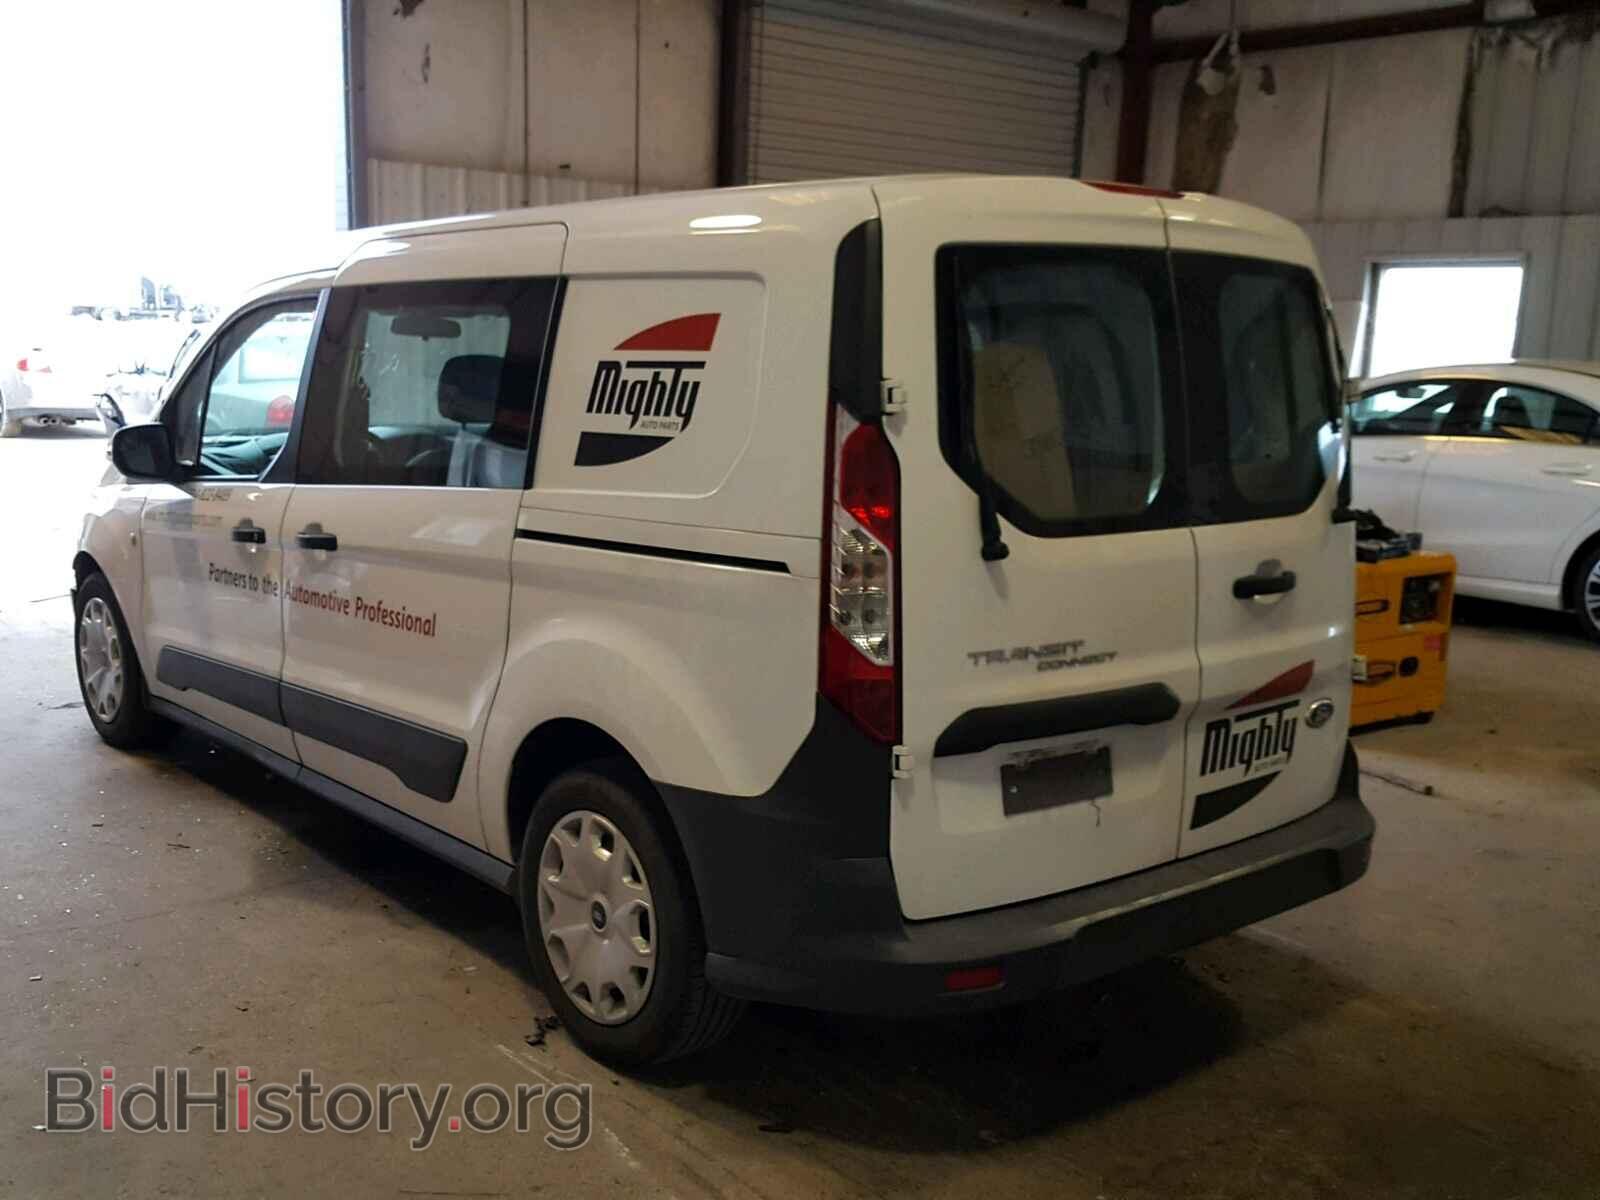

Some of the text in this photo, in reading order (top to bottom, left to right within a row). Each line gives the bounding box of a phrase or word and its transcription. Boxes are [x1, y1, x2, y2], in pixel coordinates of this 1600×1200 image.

[640, 420, 680, 431] AUTO PARTS
[208, 562, 437, 637] Partners to the Automotive Professional
[967, 640, 1085, 667] TRANSIT
[1037, 651, 1118, 672] CONNECT
